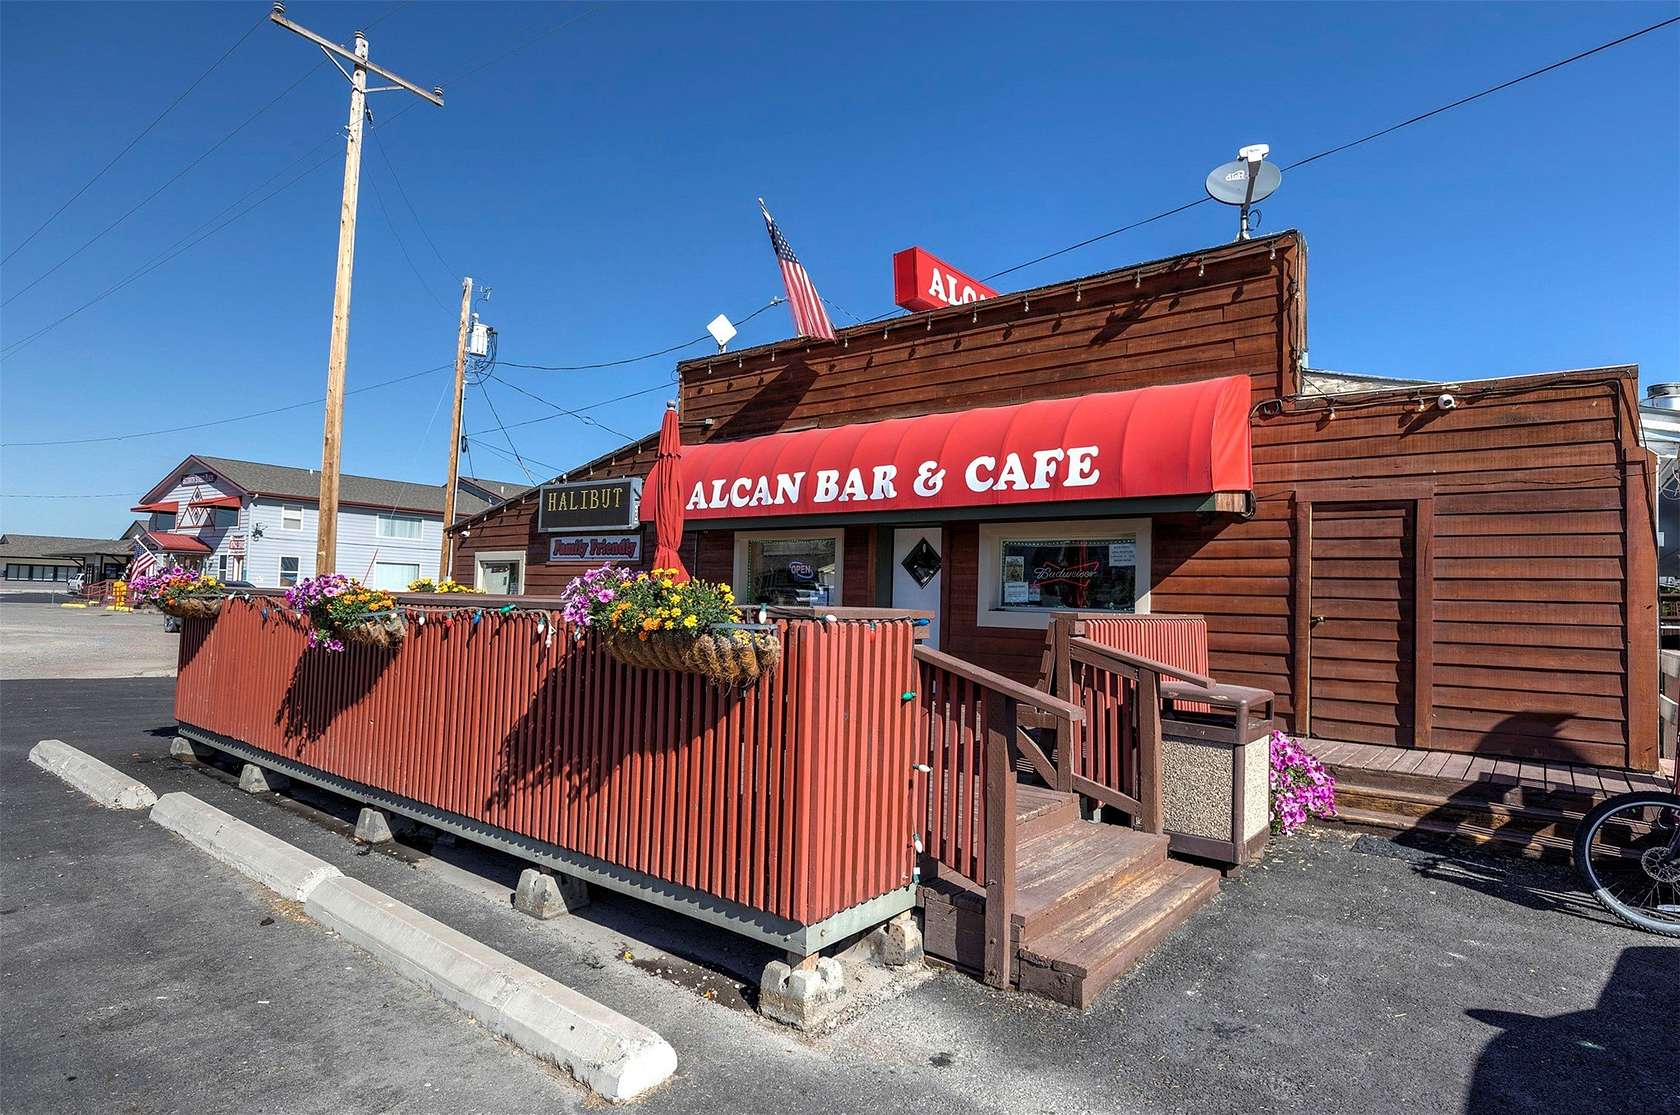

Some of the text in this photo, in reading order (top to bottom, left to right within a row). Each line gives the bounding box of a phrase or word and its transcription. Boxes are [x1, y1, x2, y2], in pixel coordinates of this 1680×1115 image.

[685, 445, 1101, 511] ALCAN BAR & CAFE
[548, 487, 623, 512] HALIBUT
[790, 564, 811, 575] OPEN
[1033, 567, 1097, 580] Budweiser
